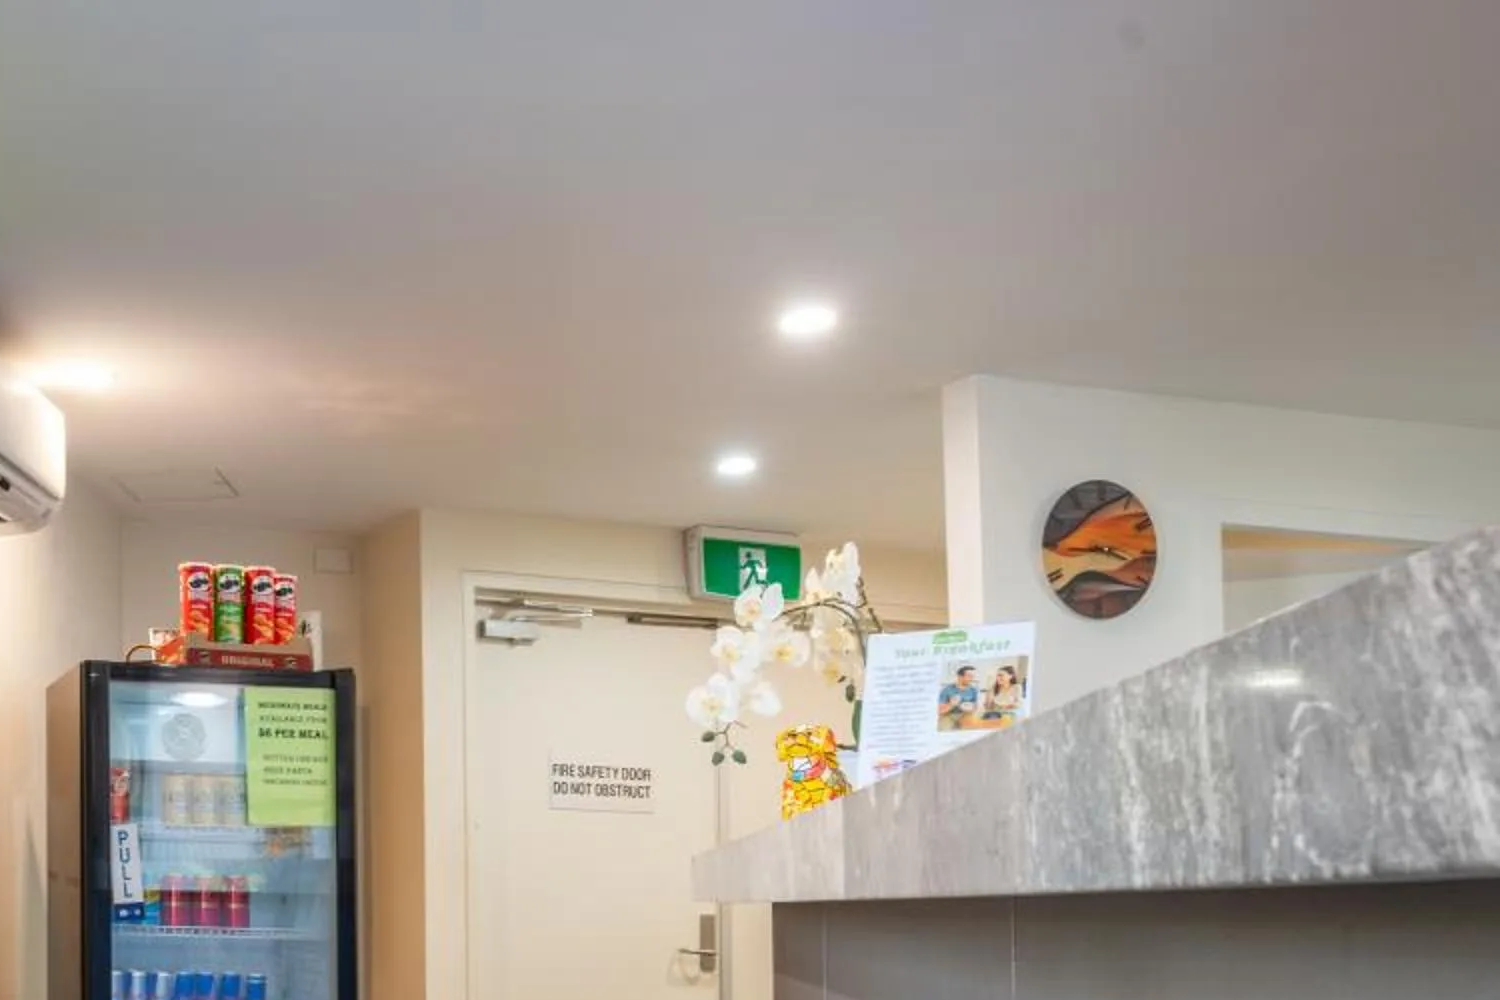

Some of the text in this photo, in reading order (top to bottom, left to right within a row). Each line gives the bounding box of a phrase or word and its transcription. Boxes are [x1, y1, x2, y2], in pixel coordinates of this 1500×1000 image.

[298, 729, 329, 740] MEAL
[551, 763, 652, 782] FIRE SAFETY DOOR
[553, 781, 652, 799] DO NOT OBSTRUCT
[117, 829, 133, 899] PULL
